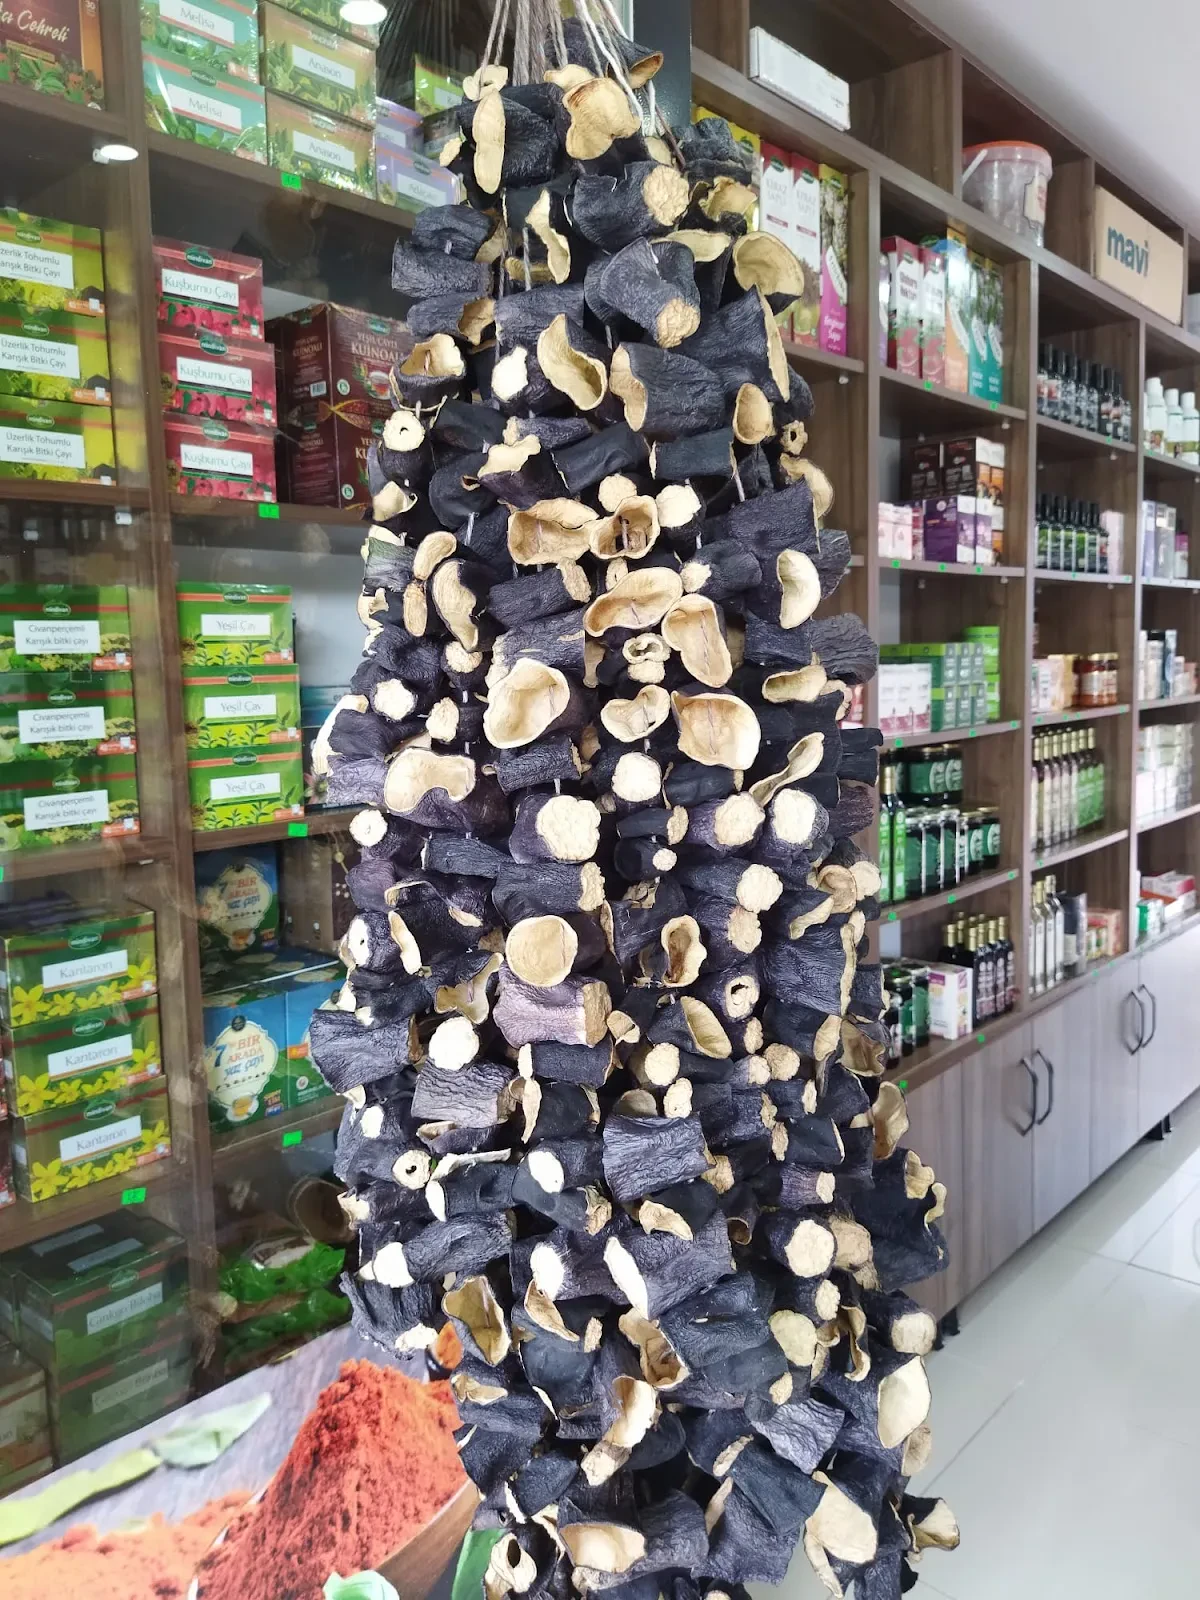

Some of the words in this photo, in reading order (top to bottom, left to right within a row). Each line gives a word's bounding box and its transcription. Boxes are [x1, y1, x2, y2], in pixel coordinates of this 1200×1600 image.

[180, 8, 215, 30] Melisa
[309, 57, 342, 78] Anason
[189, 97, 222, 119] Melisa
[308, 142, 341, 161] Anason
[24, 251, 60, 265] Tohumlu
[1107, 226, 1149, 277] mavi
[0, 261, 22, 270] arışık
[23, 263, 41, 273] Bitki
[43, 267, 60, 277] Çayı
[164, 276, 212, 294] Kuşburnu
[215, 286, 237, 300] Çayı
[1, 338, 29, 351] Üzerlik
[31, 343, 66, 356] Tohumlu
[2, 351, 29, 363] Karışık
[30, 355, 48, 365] Bitki
[49, 358, 66, 369] Çayı
[180, 363, 226, 382] Kuşburnu
[6, 431, 34, 442] Üzerlik
[35, 435, 71, 446] Tohumlu
[7, 444, 34, 456] Karışık
[35, 446, 53, 457] Bitki
[55, 449, 72, 460] Çayı
[28, 624, 85, 633] Civanperçemli
[25, 637, 52, 646] Karışık
[54, 636, 71, 645] bitki
[73, 638, 89, 646] çayı
[221, 701, 241, 713] Yeşil
[32, 712, 90, 722] Civanperçemli
[30, 725, 56, 734] Karışık
[58, 723, 75, 732] bitki
[226, 781, 246, 793] Yeşil
[38, 795, 95, 808] Civanperçemli
[63, 808, 80, 818] bitki
[60, 960, 113, 979] Kantaron
[65, 1046, 118, 1067] Kantaron
[214, 1044, 227, 1067] 7
[238, 1034, 261, 1049] BİR
[76, 1128, 127, 1151] Kantaron
